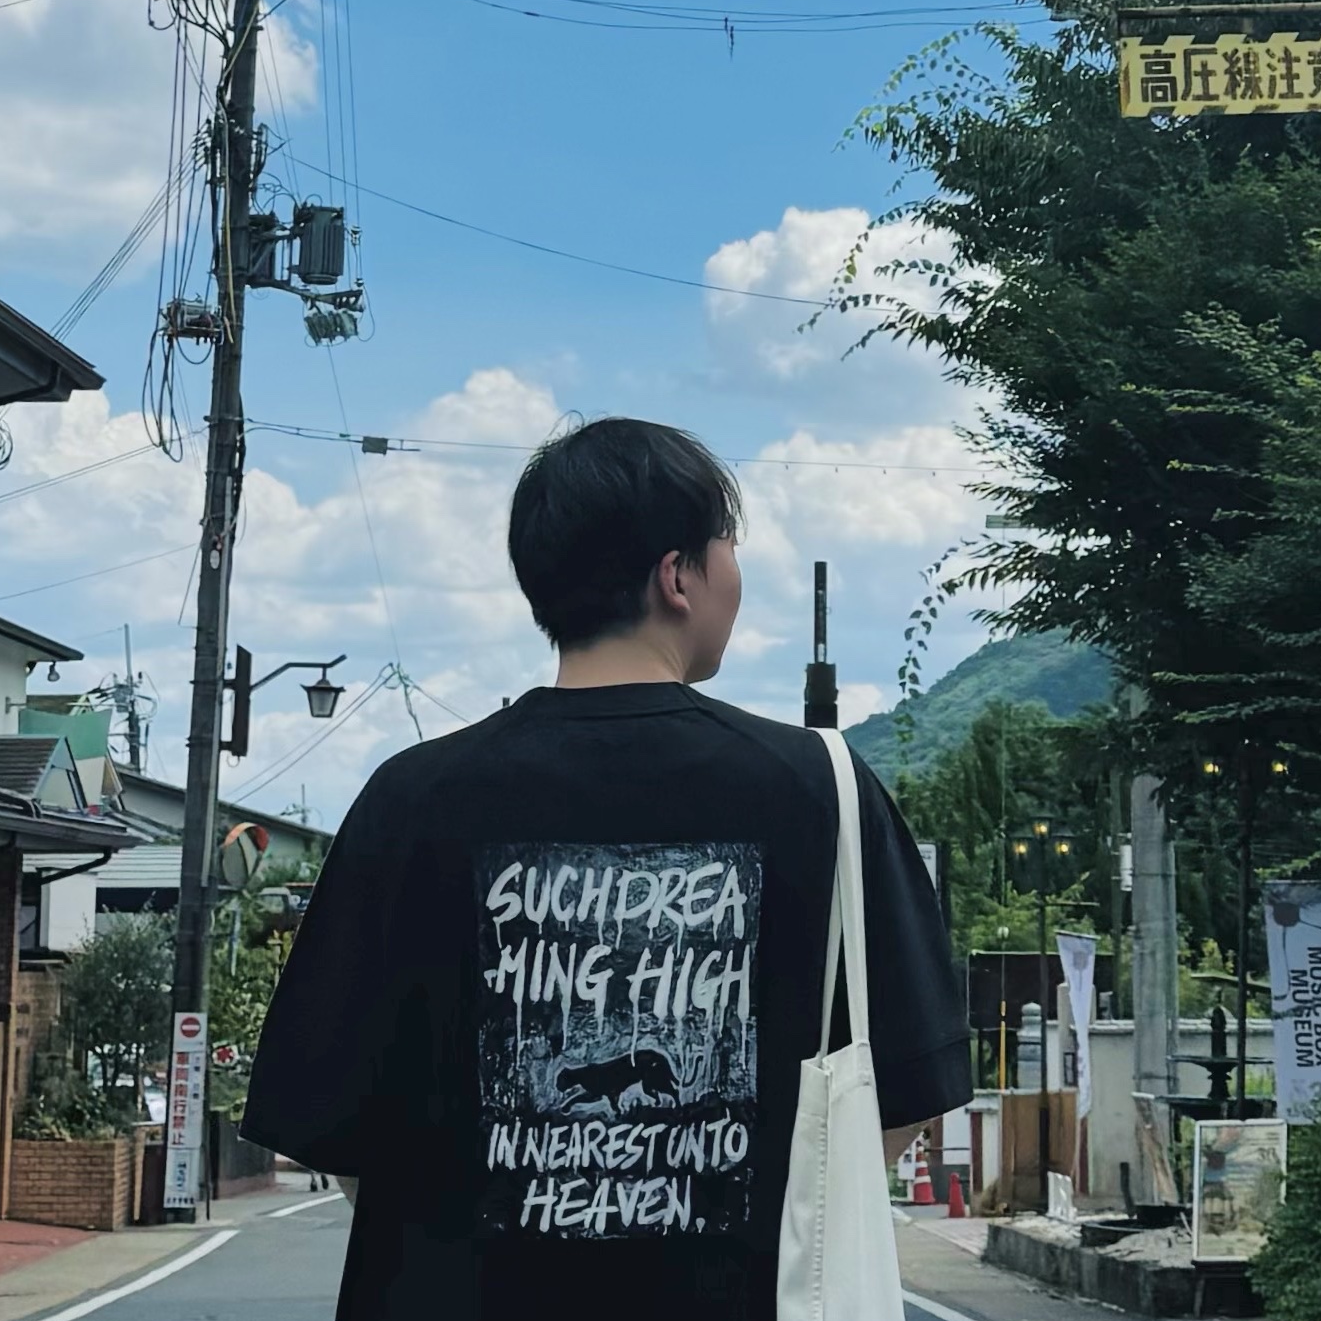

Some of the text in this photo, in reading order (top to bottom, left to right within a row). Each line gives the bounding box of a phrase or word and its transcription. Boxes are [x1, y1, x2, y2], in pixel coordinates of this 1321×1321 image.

[627, 944, 750, 1031] HIGH
[1290, 969, 1315, 1068] MUSEUM
[487, 1113, 749, 1173] IN NEAREST UNTO
